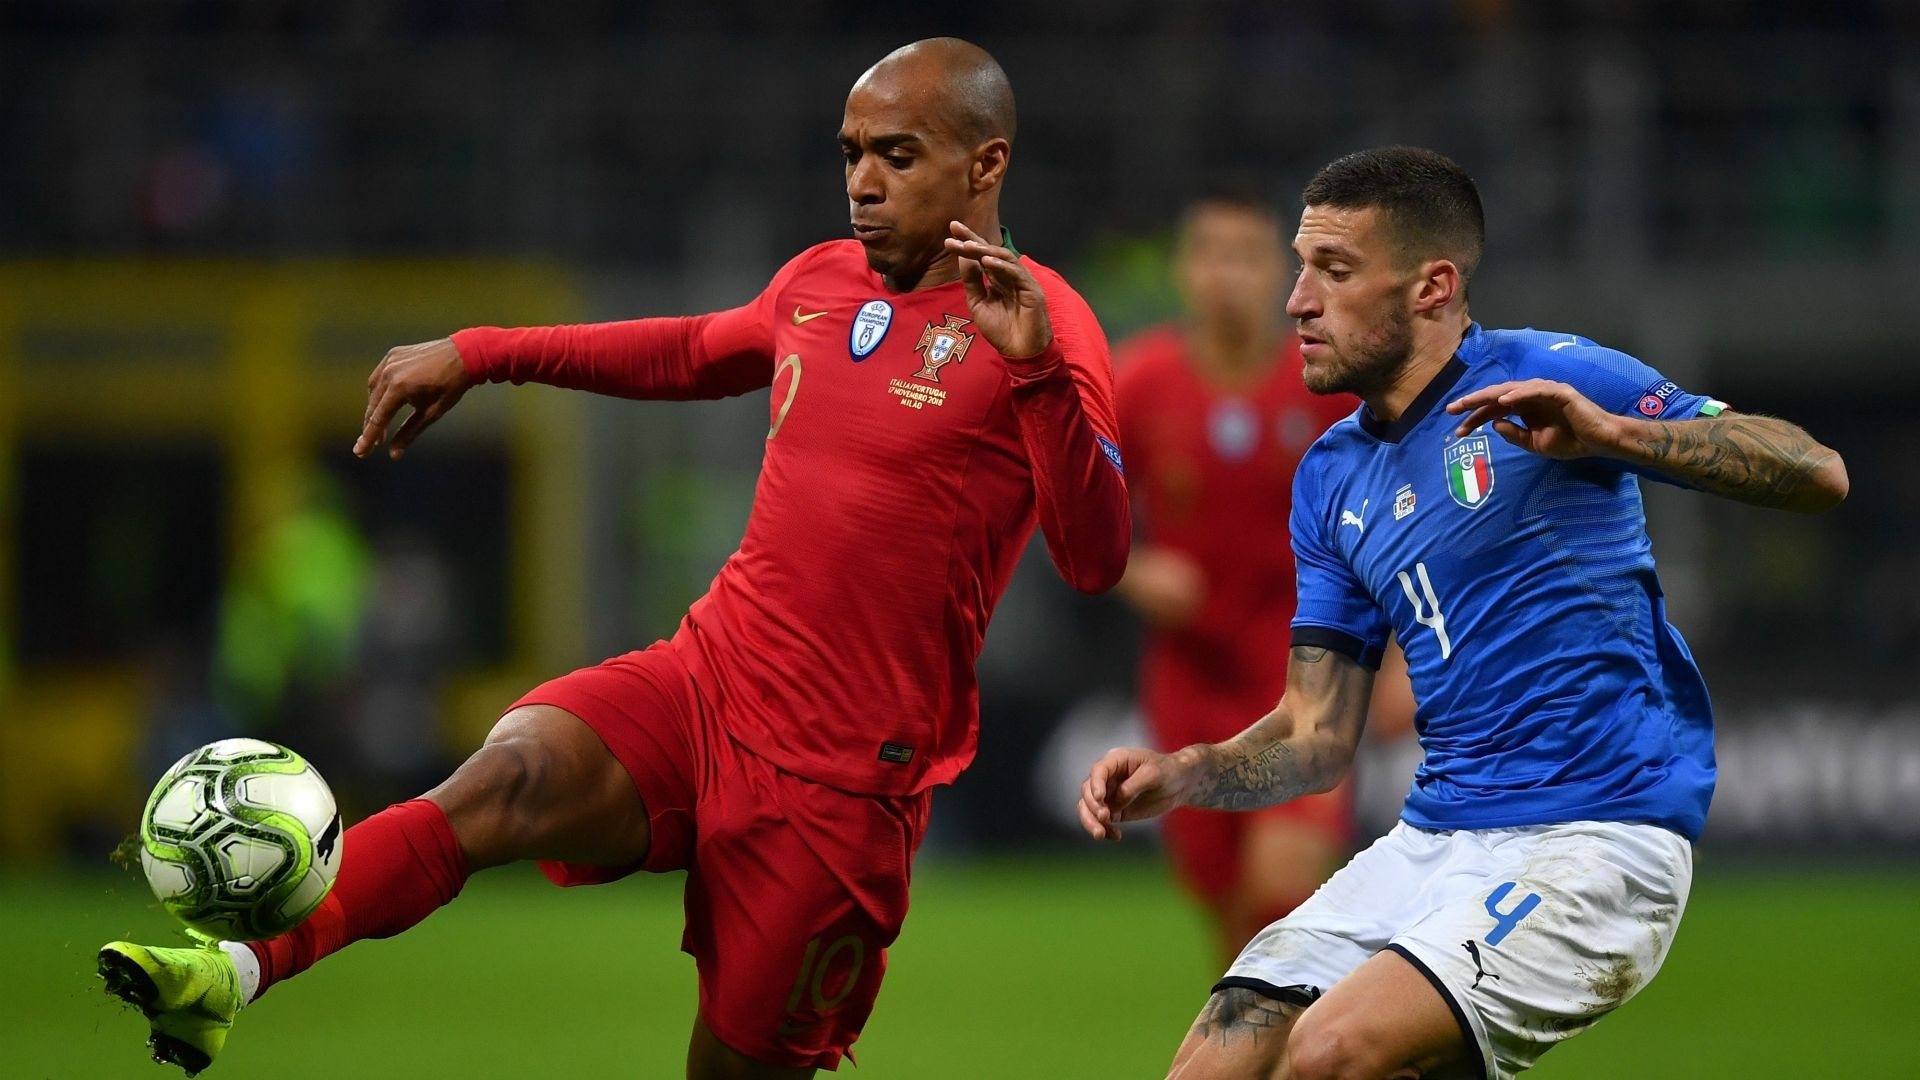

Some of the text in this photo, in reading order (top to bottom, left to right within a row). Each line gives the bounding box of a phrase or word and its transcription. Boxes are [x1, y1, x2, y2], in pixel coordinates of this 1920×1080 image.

[859, 316, 886, 327] CHAMPIONS
[861, 311, 888, 321] EUROPEAN
[894, 387, 928, 402] NOVEMBRO
[927, 396, 944, 407] 2018
[1448, 440, 1485, 461] ITALIA
[1397, 562, 1451, 660] 4
[1483, 881, 1542, 947] 4
[785, 934, 865, 1014] 10
